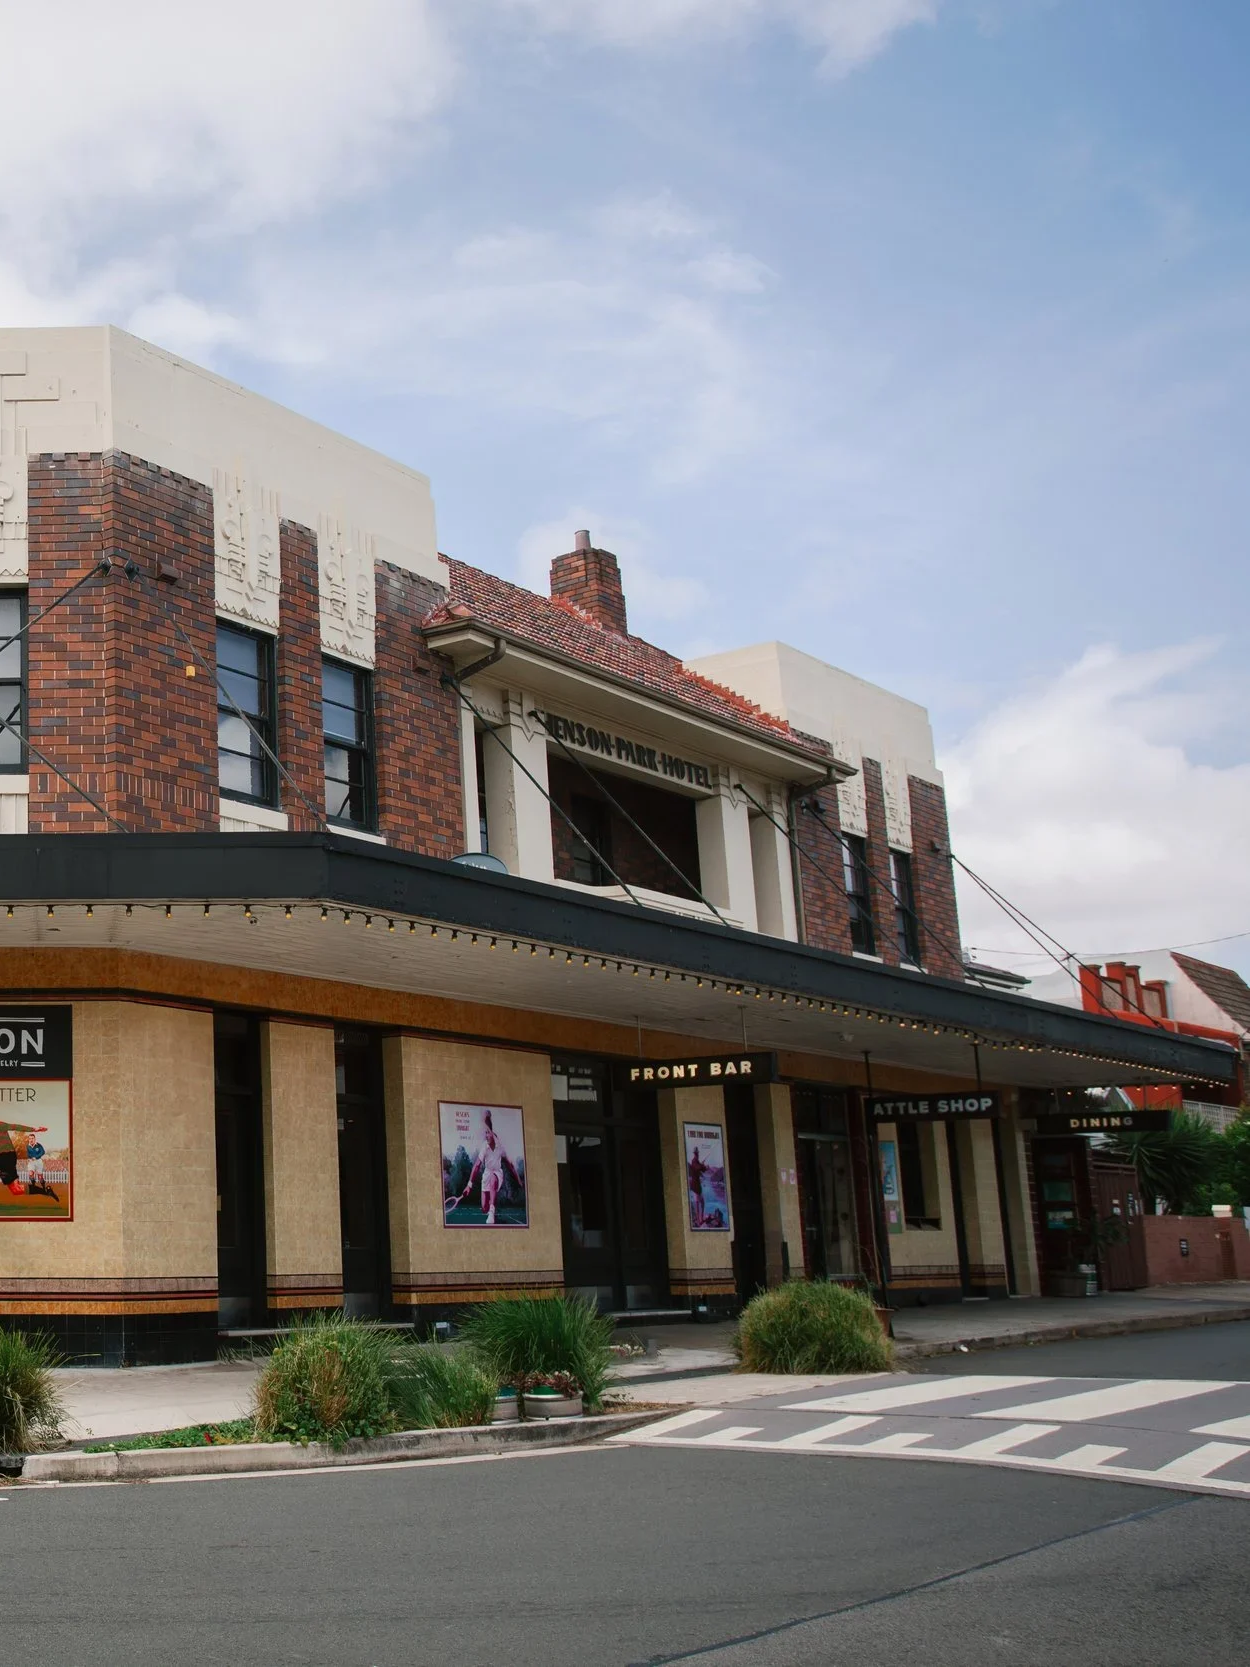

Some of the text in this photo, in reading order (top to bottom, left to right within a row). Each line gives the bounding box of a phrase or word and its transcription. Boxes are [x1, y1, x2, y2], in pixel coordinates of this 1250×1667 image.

[615, 736, 659, 772] PARK
[661, 752, 712, 789] HOTEL
[630, 1060, 752, 1081] FRONT BAR
[937, 1097, 993, 1113] SHOP
[1069, 1116, 1133, 1128] DINING
